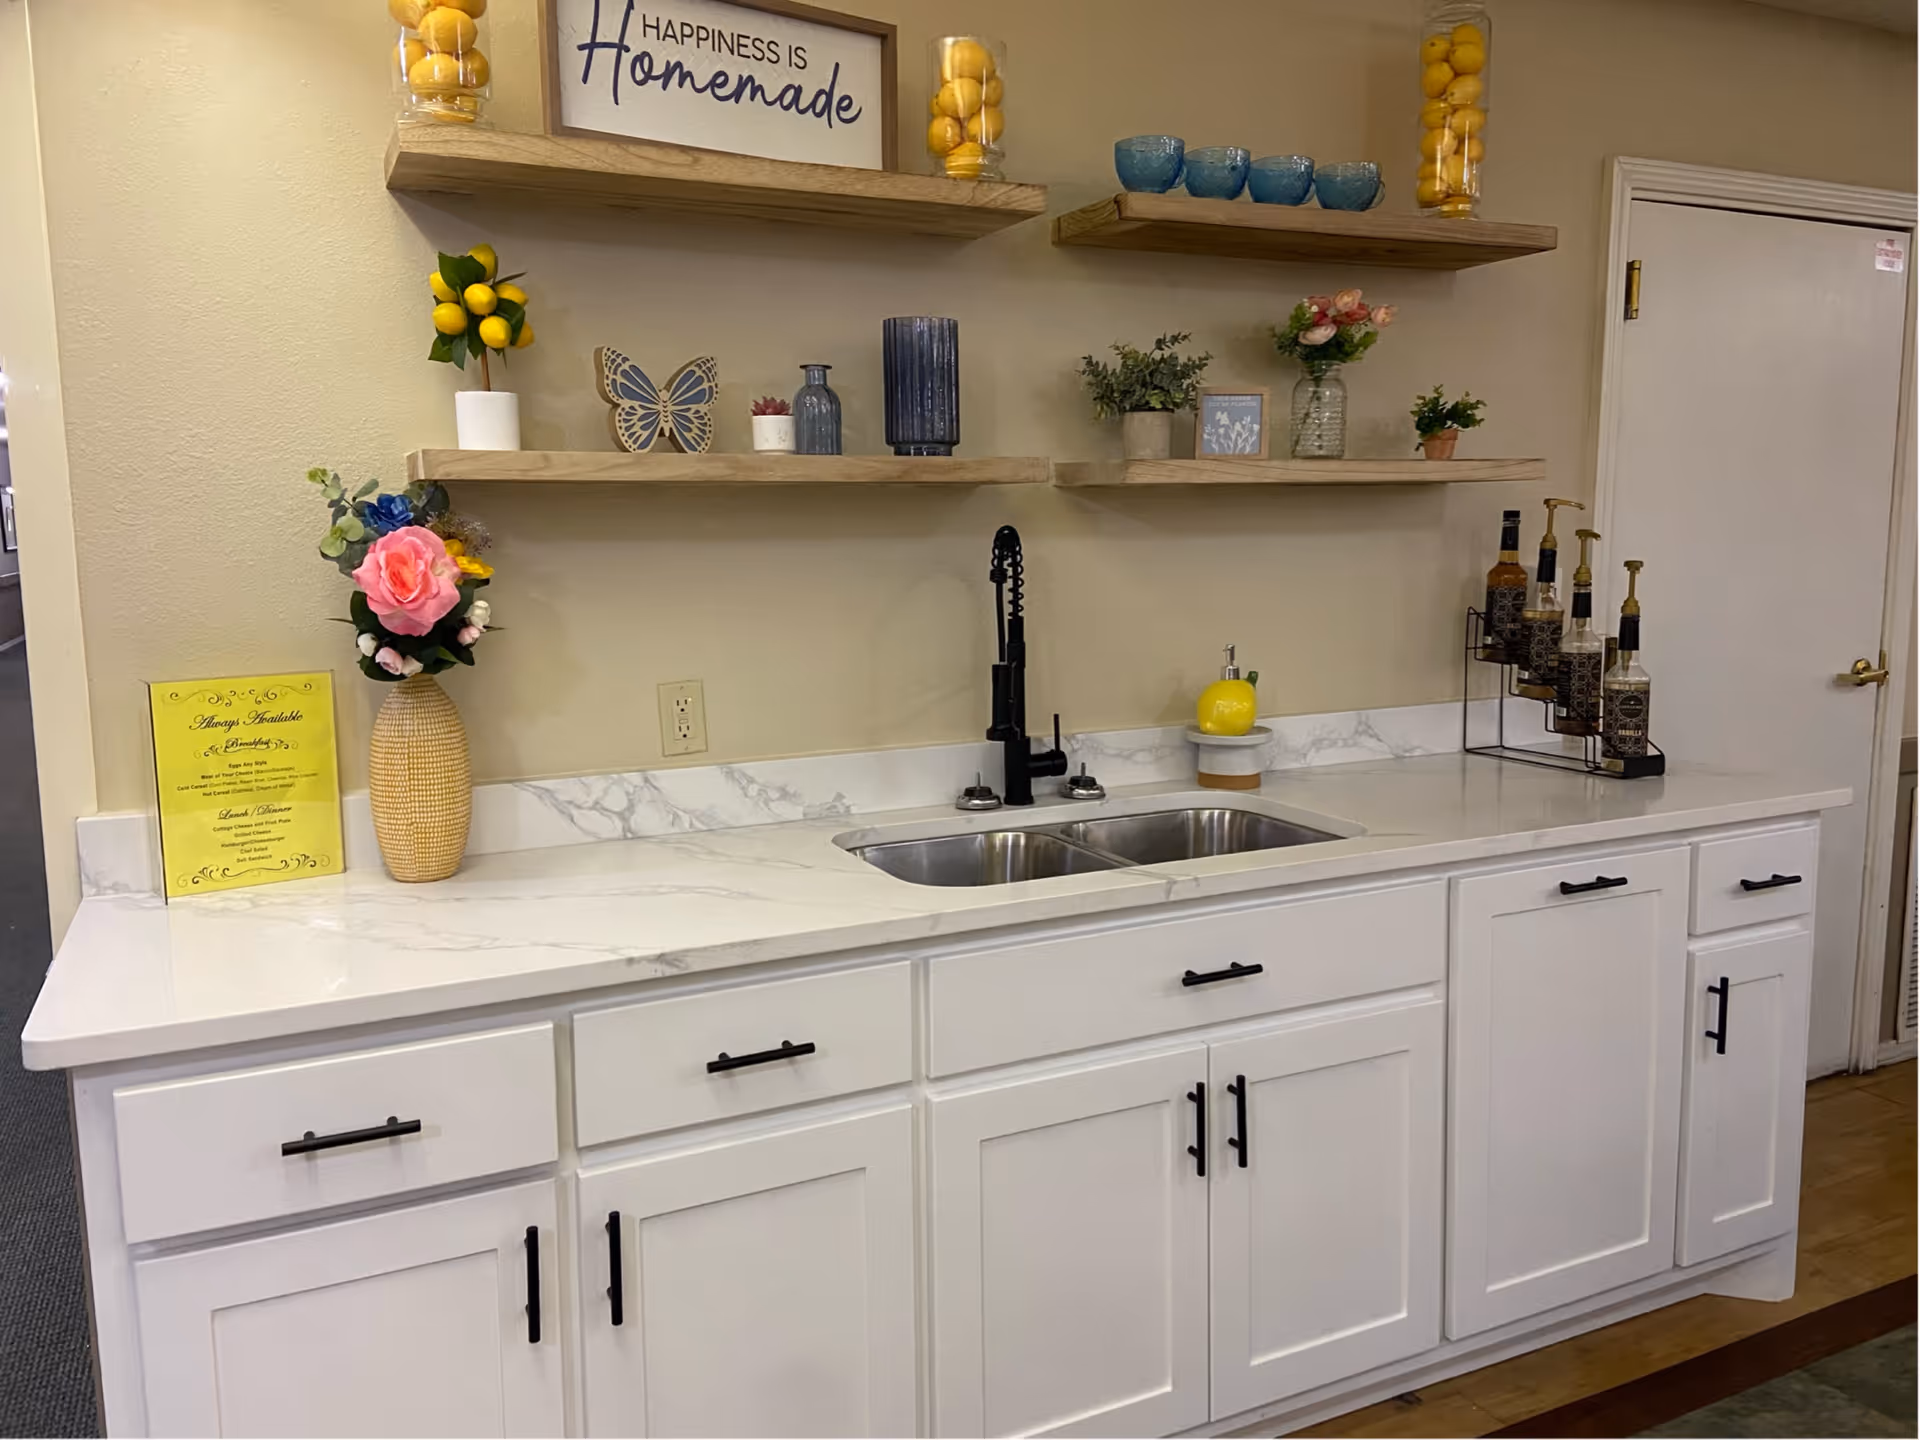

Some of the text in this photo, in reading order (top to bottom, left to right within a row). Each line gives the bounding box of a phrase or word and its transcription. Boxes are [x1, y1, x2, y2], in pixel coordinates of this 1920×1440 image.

[642, 13, 808, 70] HAPPINESS IS
[577, 0, 863, 129] Homemade
[188, 709, 304, 734] Always Available
[225, 736, 271, 749] Breakfast
[1618, 729, 1642, 737] VANILLA
[217, 808, 249, 820] Lunch
[256, 803, 292, 816] Dinner
